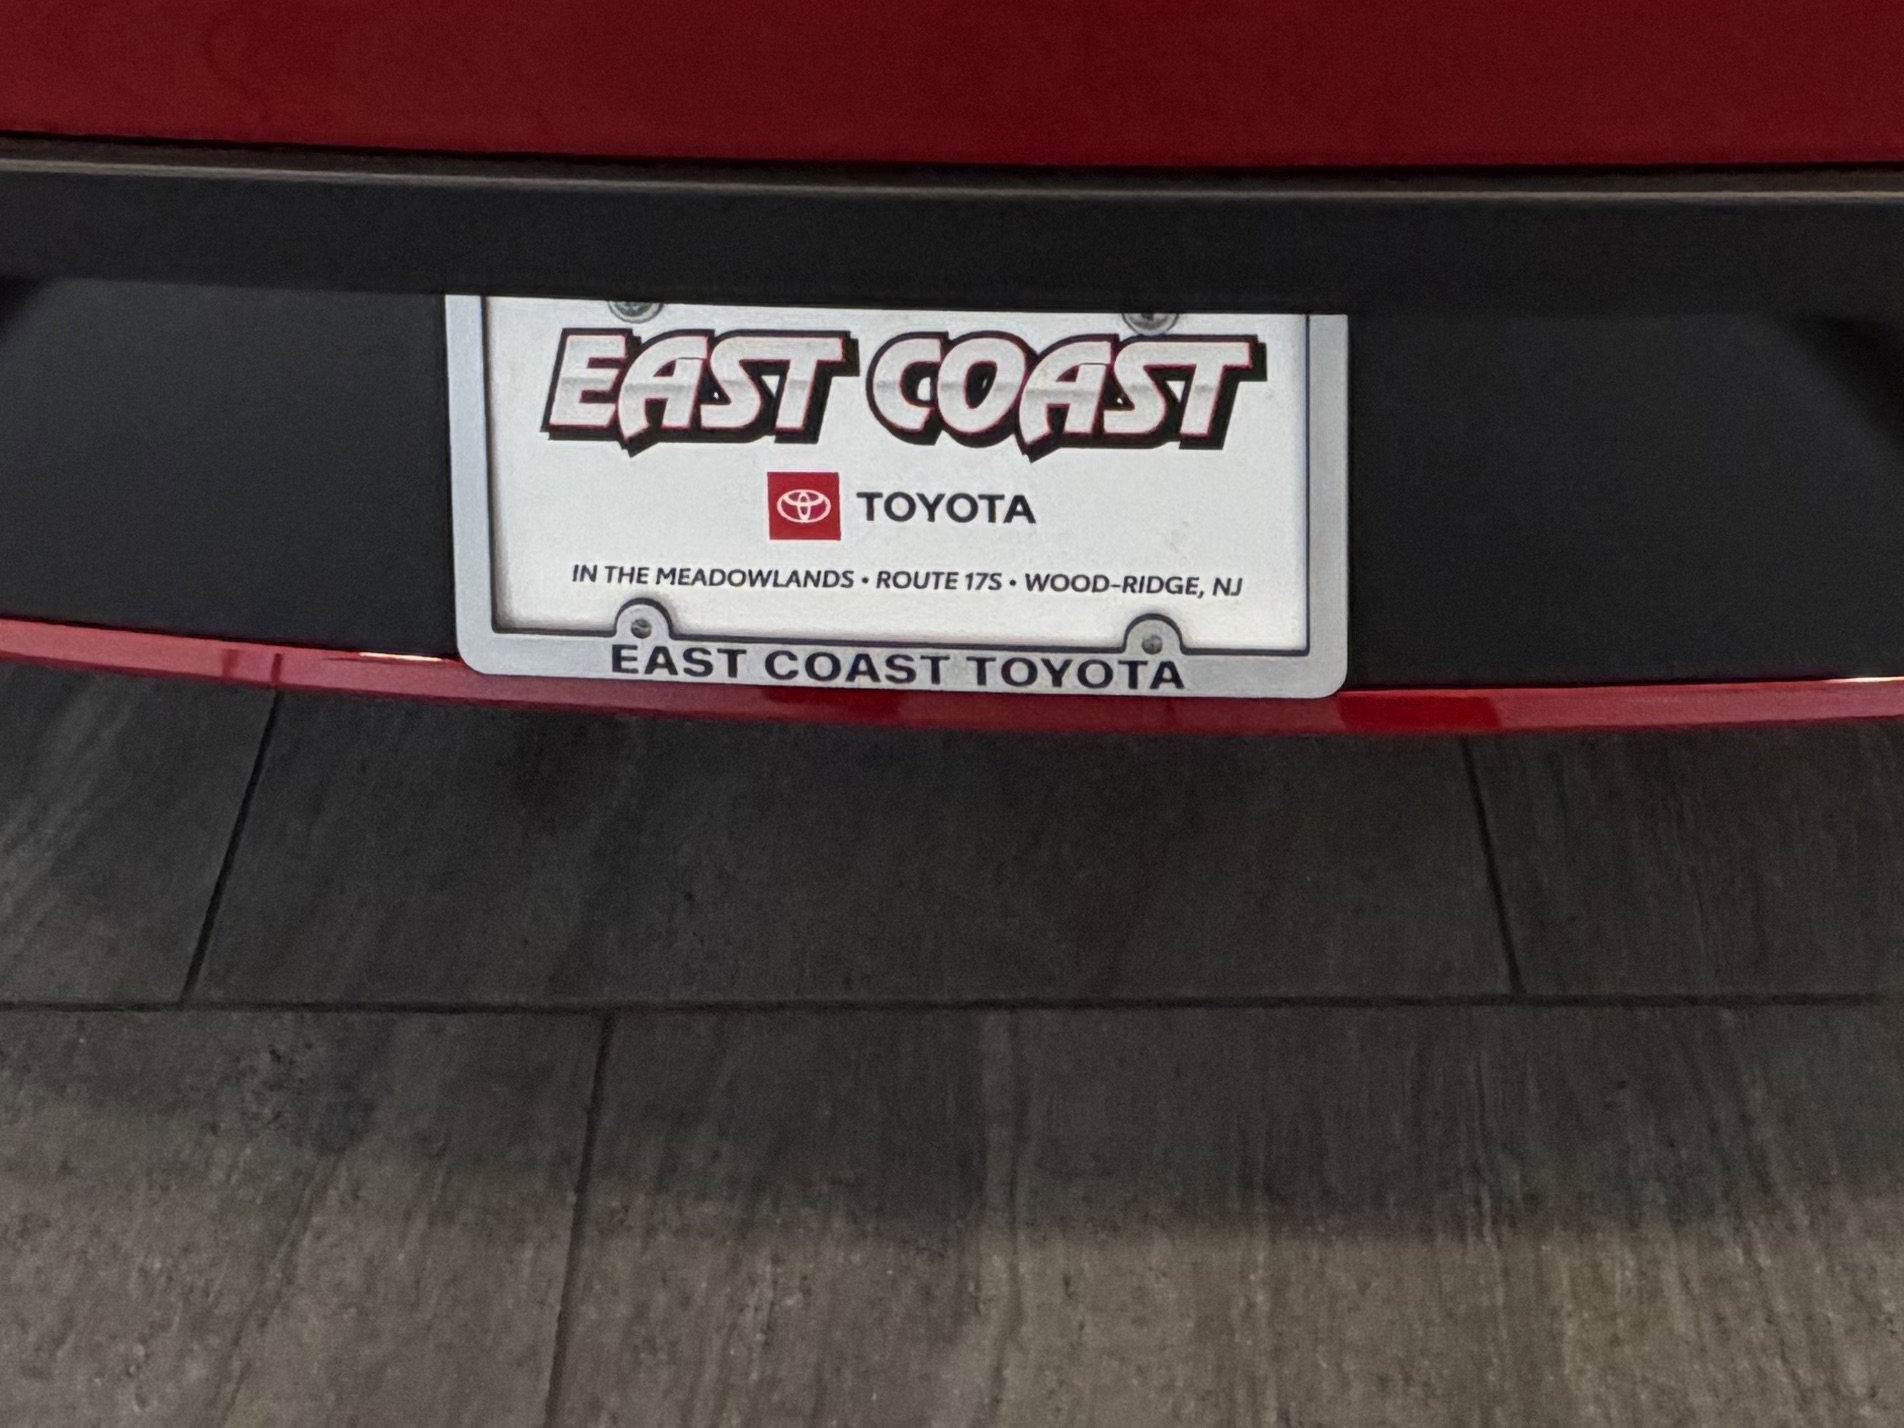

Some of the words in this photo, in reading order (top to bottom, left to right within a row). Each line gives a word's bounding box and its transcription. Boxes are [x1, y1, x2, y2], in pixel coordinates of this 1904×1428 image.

[541, 327, 860, 457] EAST
[866, 330, 1268, 463] COAST
[856, 491, 1037, 525] TOYOTA
[571, 563, 598, 583] IN
[604, 565, 650, 586] THE
[655, 567, 856, 589] MEADOWLANDS
[876, 570, 959, 591] ROUTE
[1024, 573, 1206, 599] WOOD-RIDGE,
[1211, 577, 1245, 597] NJ
[611, 644, 747, 678] EAST
[764, 649, 950, 685] COAST
[966, 656, 1185, 690] TOYOTA
